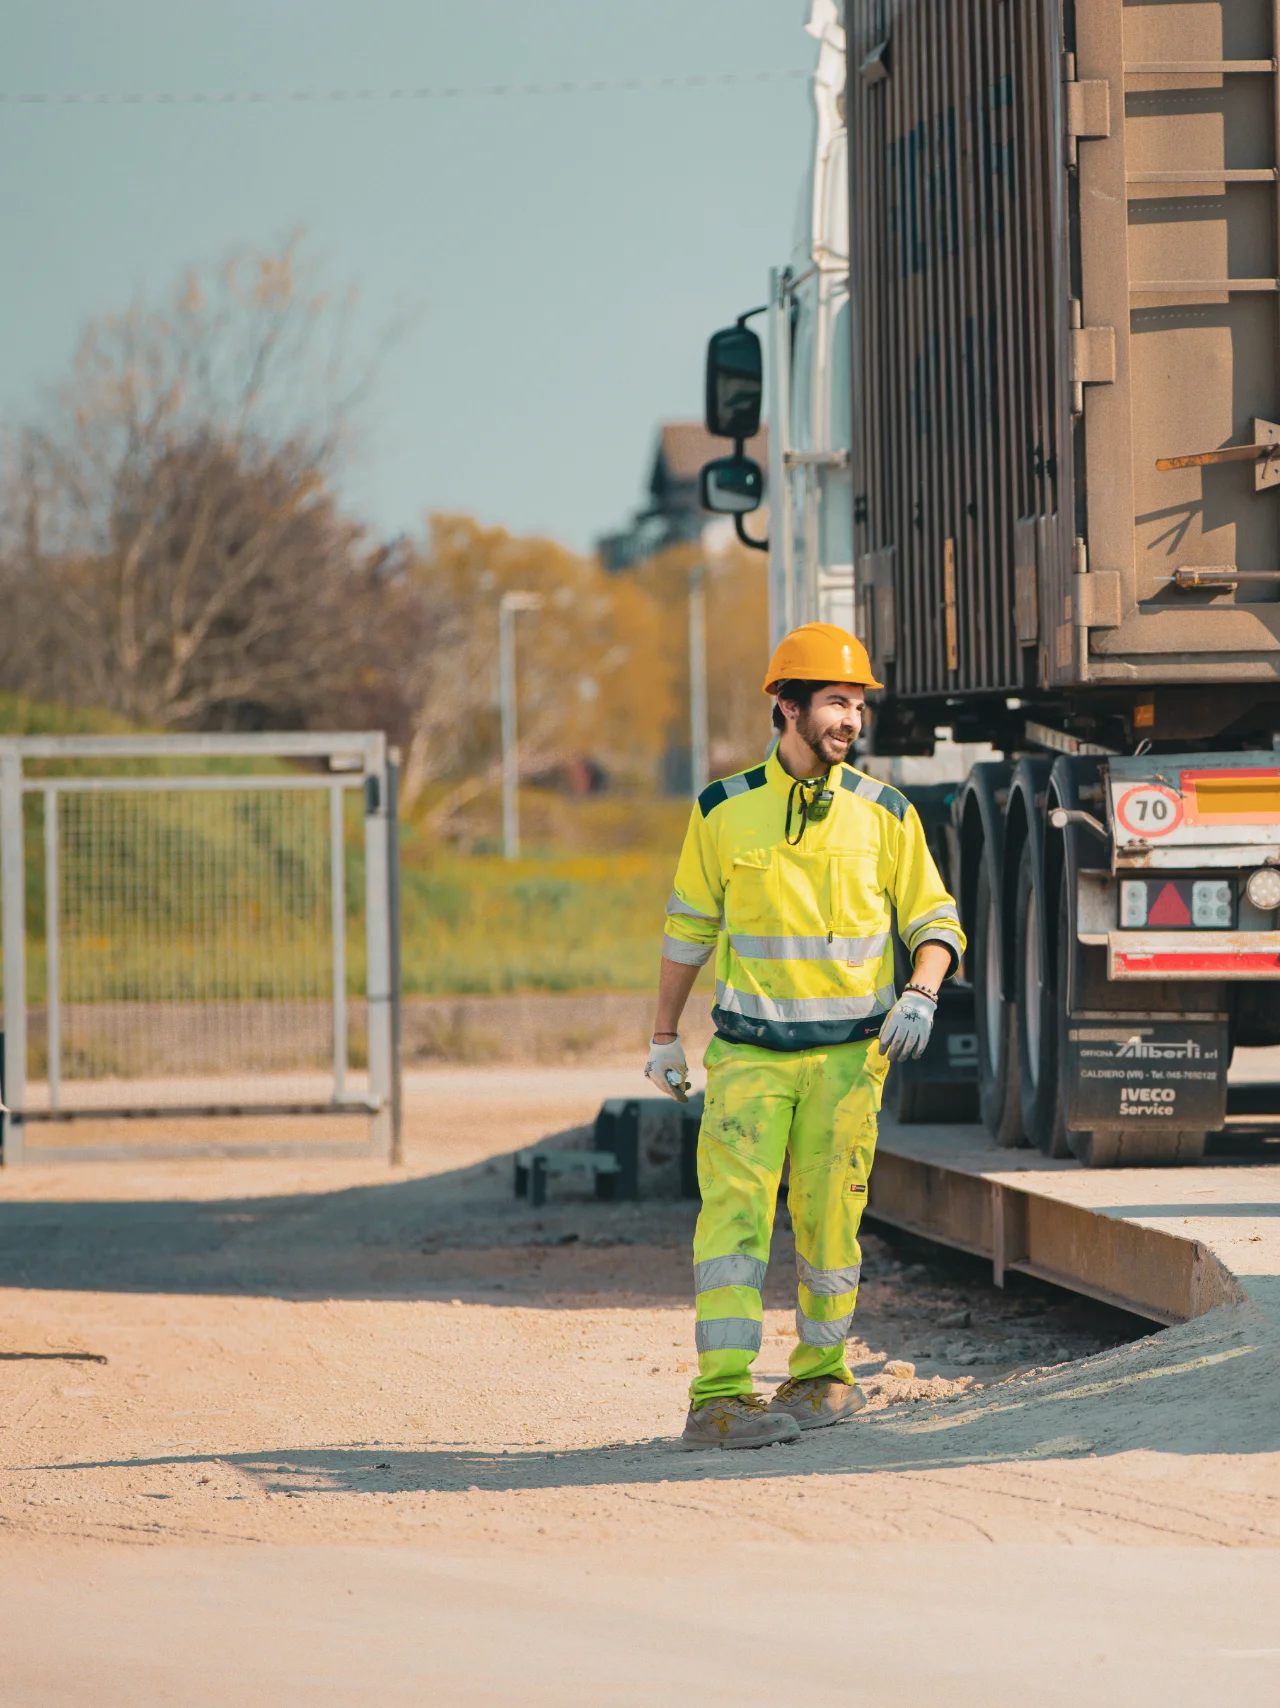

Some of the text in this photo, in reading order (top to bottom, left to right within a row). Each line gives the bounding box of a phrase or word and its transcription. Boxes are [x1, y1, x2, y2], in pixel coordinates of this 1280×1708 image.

[1136, 800, 1167, 821] 70
[1080, 1036, 1218, 1059] OFFICINA Alberti srl
[1080, 1069, 1125, 1079] CALDIERO
[1126, 1069, 1144, 1081] (VR)
[1120, 1088, 1176, 1101] IVECO
[1119, 1103, 1174, 1116] Service
